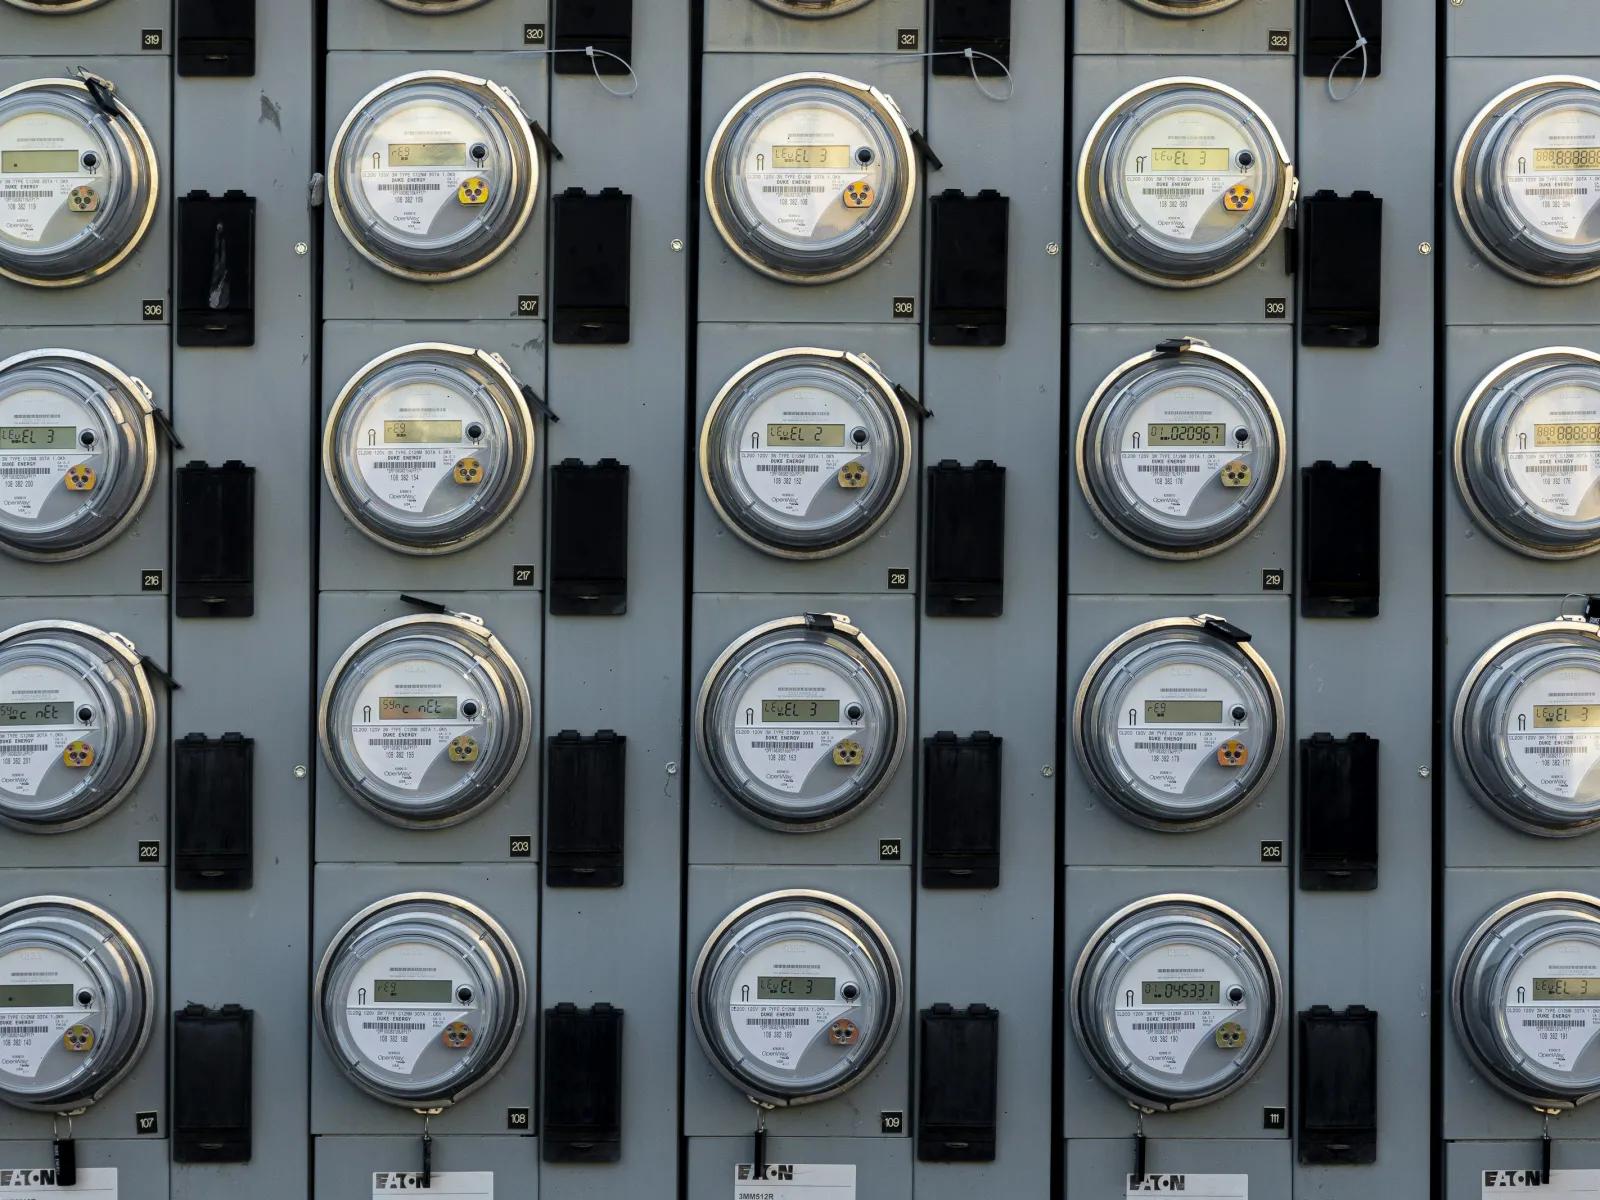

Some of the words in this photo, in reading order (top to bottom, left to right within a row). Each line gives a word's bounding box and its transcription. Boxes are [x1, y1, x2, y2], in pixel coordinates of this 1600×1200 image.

[527, 29, 543, 38] 320
[145, 35, 159, 44] 319
[901, 35, 914, 44] 321
[1271, 36, 1287, 46] 323
[820, 148, 827, 162] 3
[1200, 151, 1206, 165] 3
[145, 305, 161, 315] 306
[520, 301, 536, 310] 307
[895, 303, 912, 312] 308
[1267, 303, 1284, 313] 309
[47, 430, 54, 443] 3
[814, 427, 822, 441] 2
[1171, 426, 1219, 440] 020967
[517, 571, 530, 580] 217
[892, 574, 905, 583] 218
[1266, 575, 1280, 584] 219
[145, 576, 158, 585] 216
[810, 702, 817, 716] 3
[1582, 708, 1588, 721] 3
[512, 842, 528, 851] 203
[882, 845, 898, 854] 204
[141, 847, 157, 856] 202
[1264, 847, 1279, 856] 205
[806, 980, 812, 994] 3
[1165, 984, 1213, 998] 045331
[1581, 980, 1588, 994] 3
[140, 1118, 153, 1127] 107
[512, 1114, 525, 1123] 108
[885, 1118, 899, 1127] 109
[1271, 1114, 1279, 1122] 111
[1, 1170, 55, 1186] EATON
[1484, 1171, 1540, 1186] EATON
